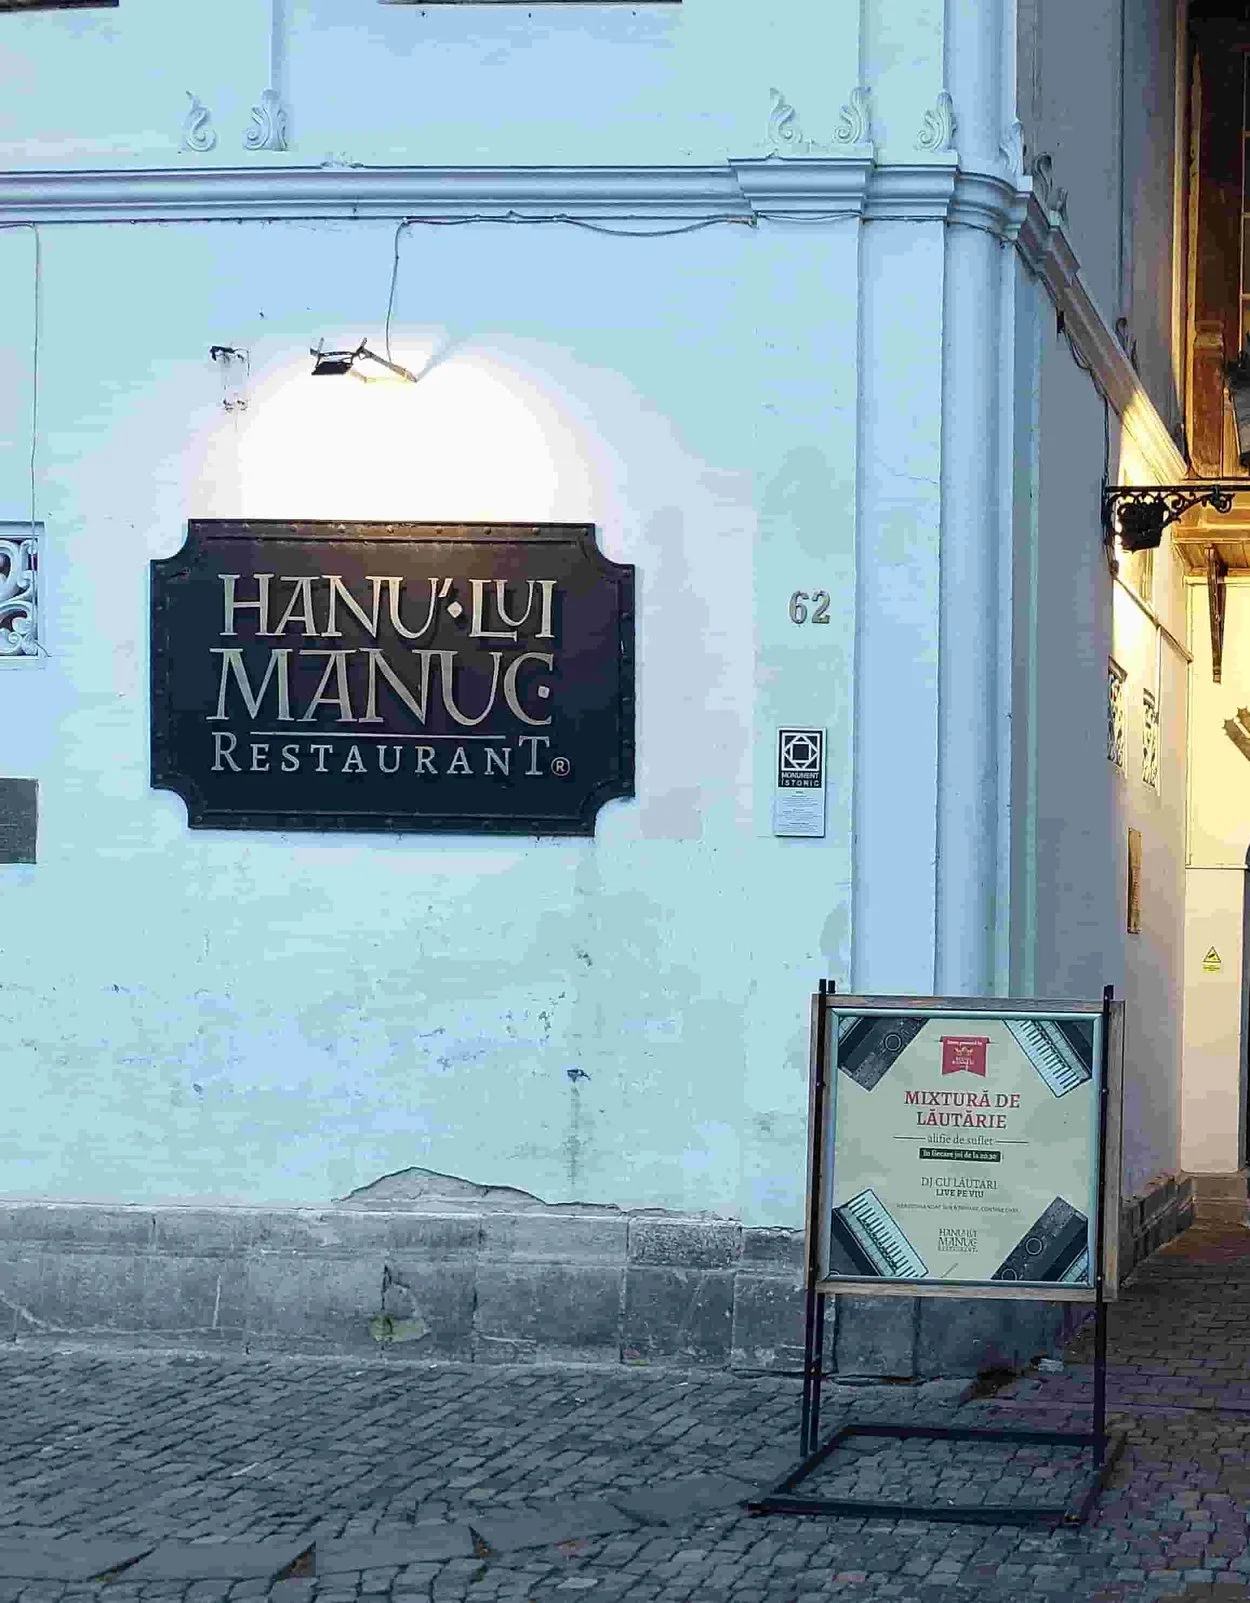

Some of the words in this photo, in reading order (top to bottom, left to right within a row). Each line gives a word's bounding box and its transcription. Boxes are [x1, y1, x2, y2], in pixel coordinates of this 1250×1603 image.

[789, 590, 831, 625] 62
[781, 771, 819, 779] MONUMENT
[904, 1090, 991, 1107] MIXTURĂ
[994, 1093, 1020, 1108] DE
[917, 1108, 1007, 1129] LĂUTĂRIE
[927, 1133, 950, 1144] alifie
[952, 1134, 963, 1144] de
[966, 1135, 993, 1146] suflet
[921, 1176, 933, 1188] DJ
[935, 1177, 950, 1188] CU
[936, 1189, 955, 1197] LIVE
[957, 1189, 968, 1198] PE
[969, 1190, 984, 1198] VIU
